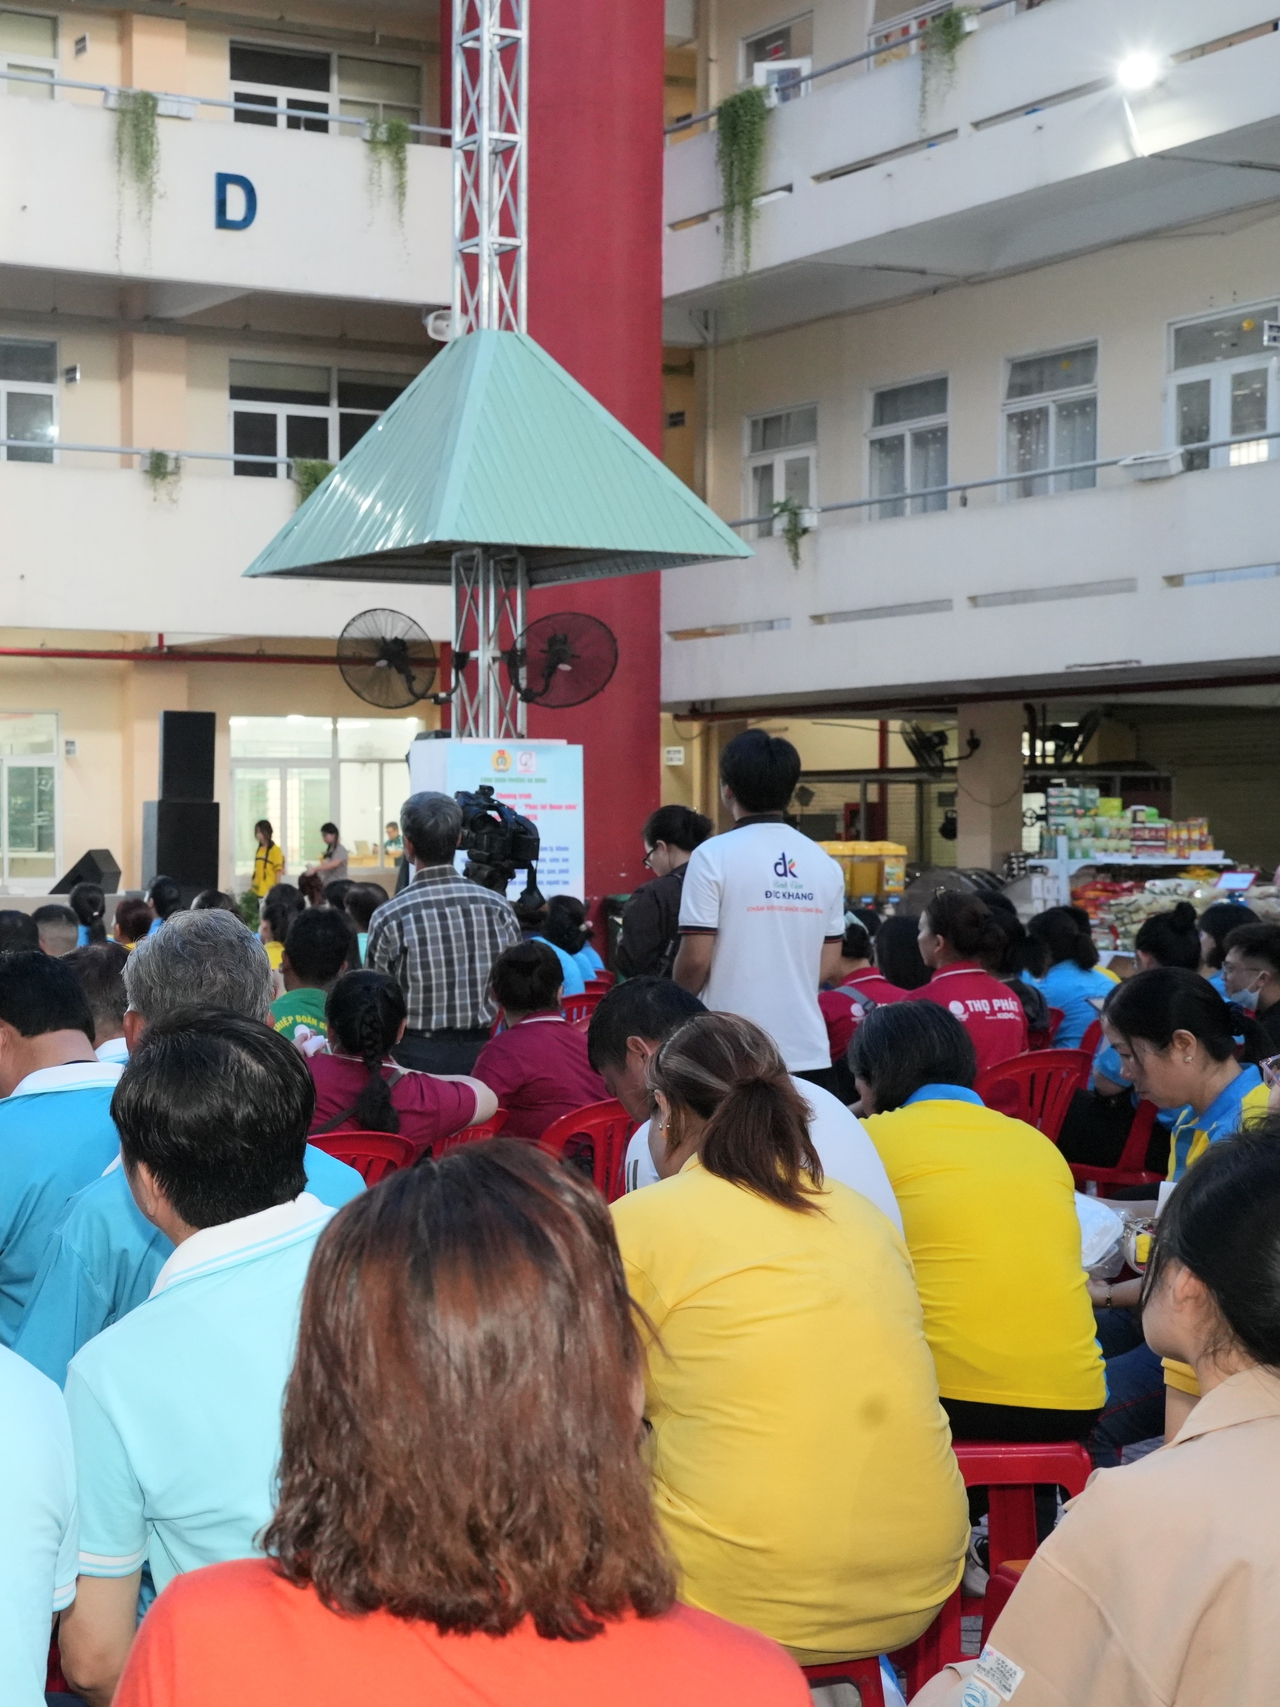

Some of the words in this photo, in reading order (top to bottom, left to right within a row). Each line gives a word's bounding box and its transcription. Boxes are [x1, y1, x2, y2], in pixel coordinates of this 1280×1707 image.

[214, 172, 258, 231] D
[782, 891, 814, 901] KHANG
[965, 999, 991, 1014] THỌ
[992, 997, 1019, 1012] PHÁT
